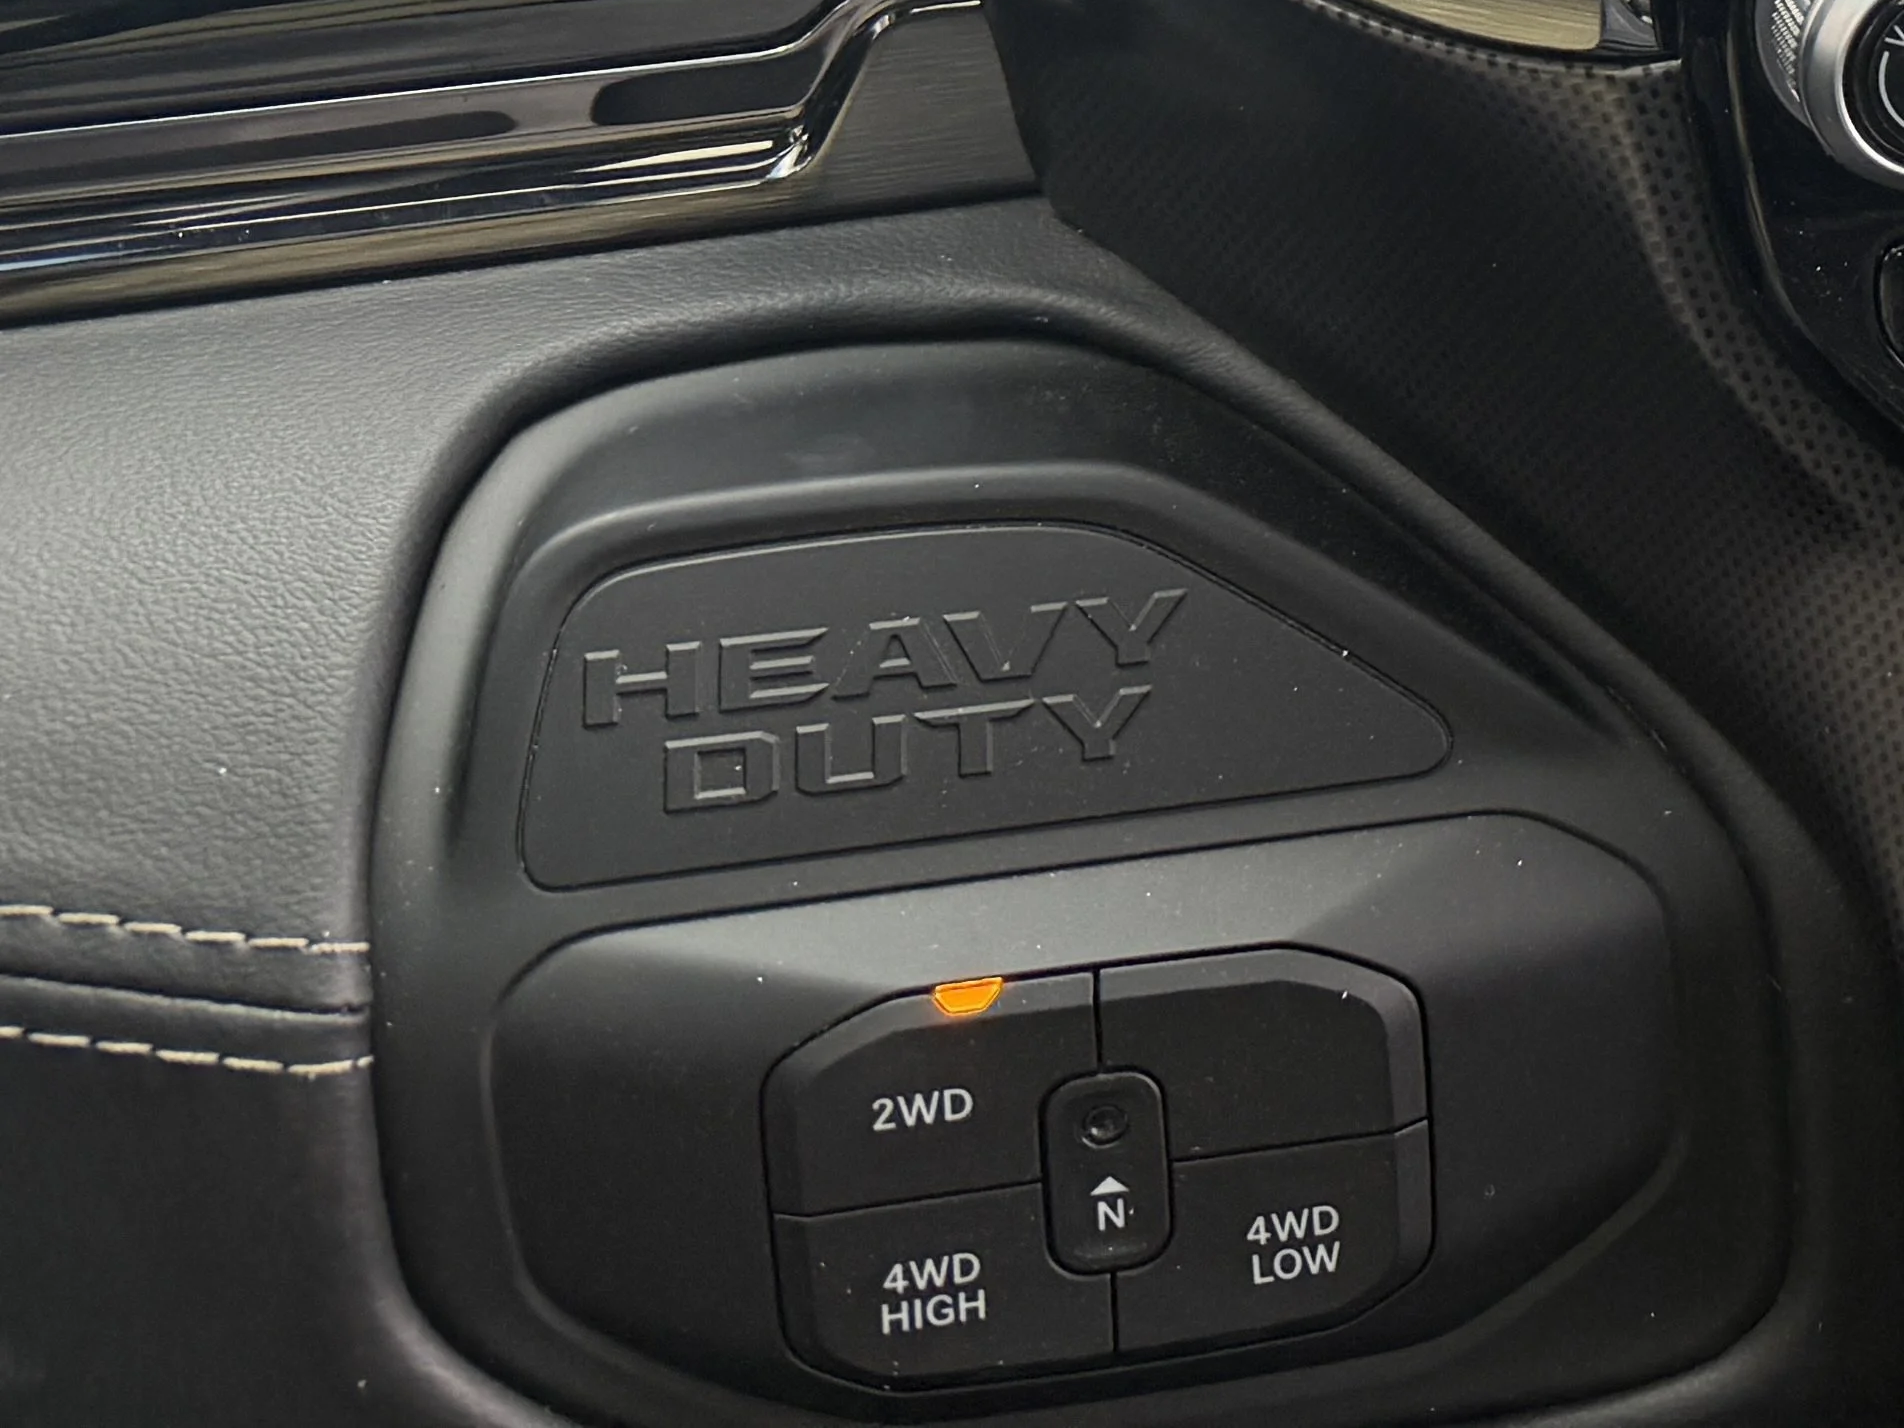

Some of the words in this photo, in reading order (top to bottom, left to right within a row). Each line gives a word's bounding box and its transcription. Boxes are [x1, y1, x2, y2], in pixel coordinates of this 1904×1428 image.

[583, 587, 1187, 728] HEAVY
[663, 684, 1153, 814] DUTY
[871, 1088, 974, 1132] 2WD
[1097, 1197, 1126, 1231] N
[1246, 1205, 1341, 1246] 4WD
[883, 1252, 982, 1294] 4WD
[1251, 1241, 1342, 1285] LOW
[881, 1288, 988, 1335] HIGH
